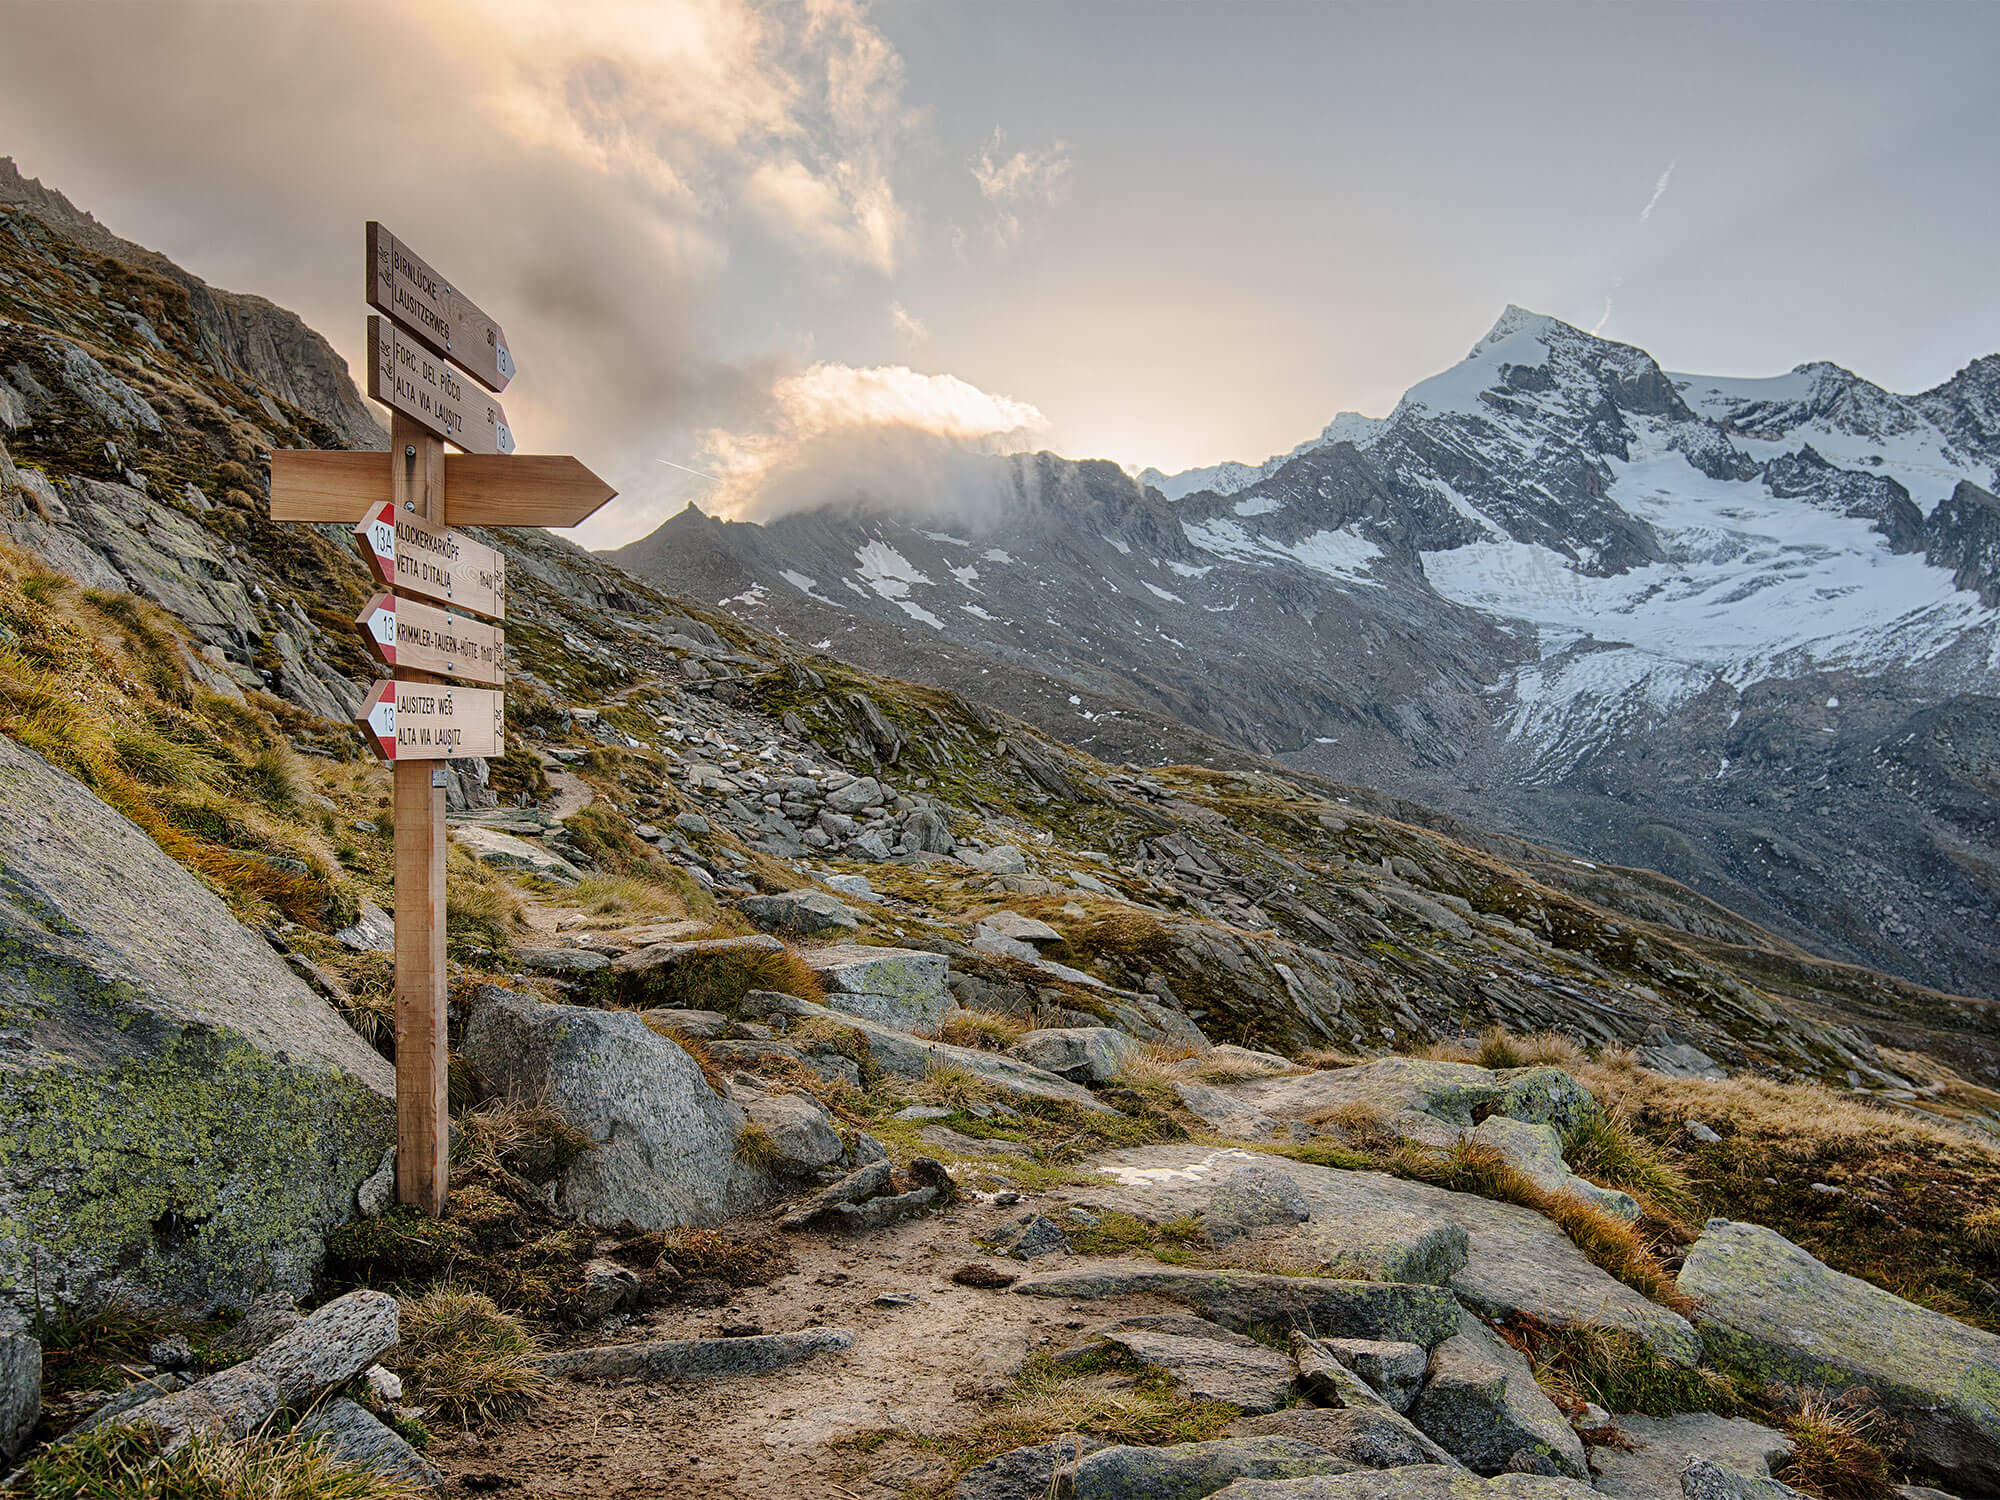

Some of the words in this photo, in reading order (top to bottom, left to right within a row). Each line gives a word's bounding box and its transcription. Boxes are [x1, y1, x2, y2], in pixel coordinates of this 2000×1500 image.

[394, 250, 437, 301] BIRNLÜCKE
[394, 283, 450, 340] LAUSITZERWEG
[396, 343, 418, 374] FORC.
[423, 361, 436, 386] DEL
[440, 374, 461, 402] PICCO
[498, 349, 506, 372] 13
[396, 375, 416, 404] ALTA
[419, 390, 431, 414] VIA
[434, 400, 462, 433] LAUSITZ
[498, 425, 506, 449] 13
[375, 525, 393, 554] 13A
[396, 520, 460, 562] KLOCKERKARKOPF
[396, 553, 420, 578] VETTA
[423, 563, 451, 588] D'ITALIA
[383, 615, 394, 641] 13
[397, 622, 478, 660] KRIMMLER-TAUERN-HÜTTE
[383, 707, 394, 732] 13
[397, 695, 435, 715] LAUSITZER
[438, 698, 454, 716] WEG
[398, 727, 417, 746] ALTA
[420, 727, 432, 746] VIA
[435, 728, 461, 746] LAUSITZ
